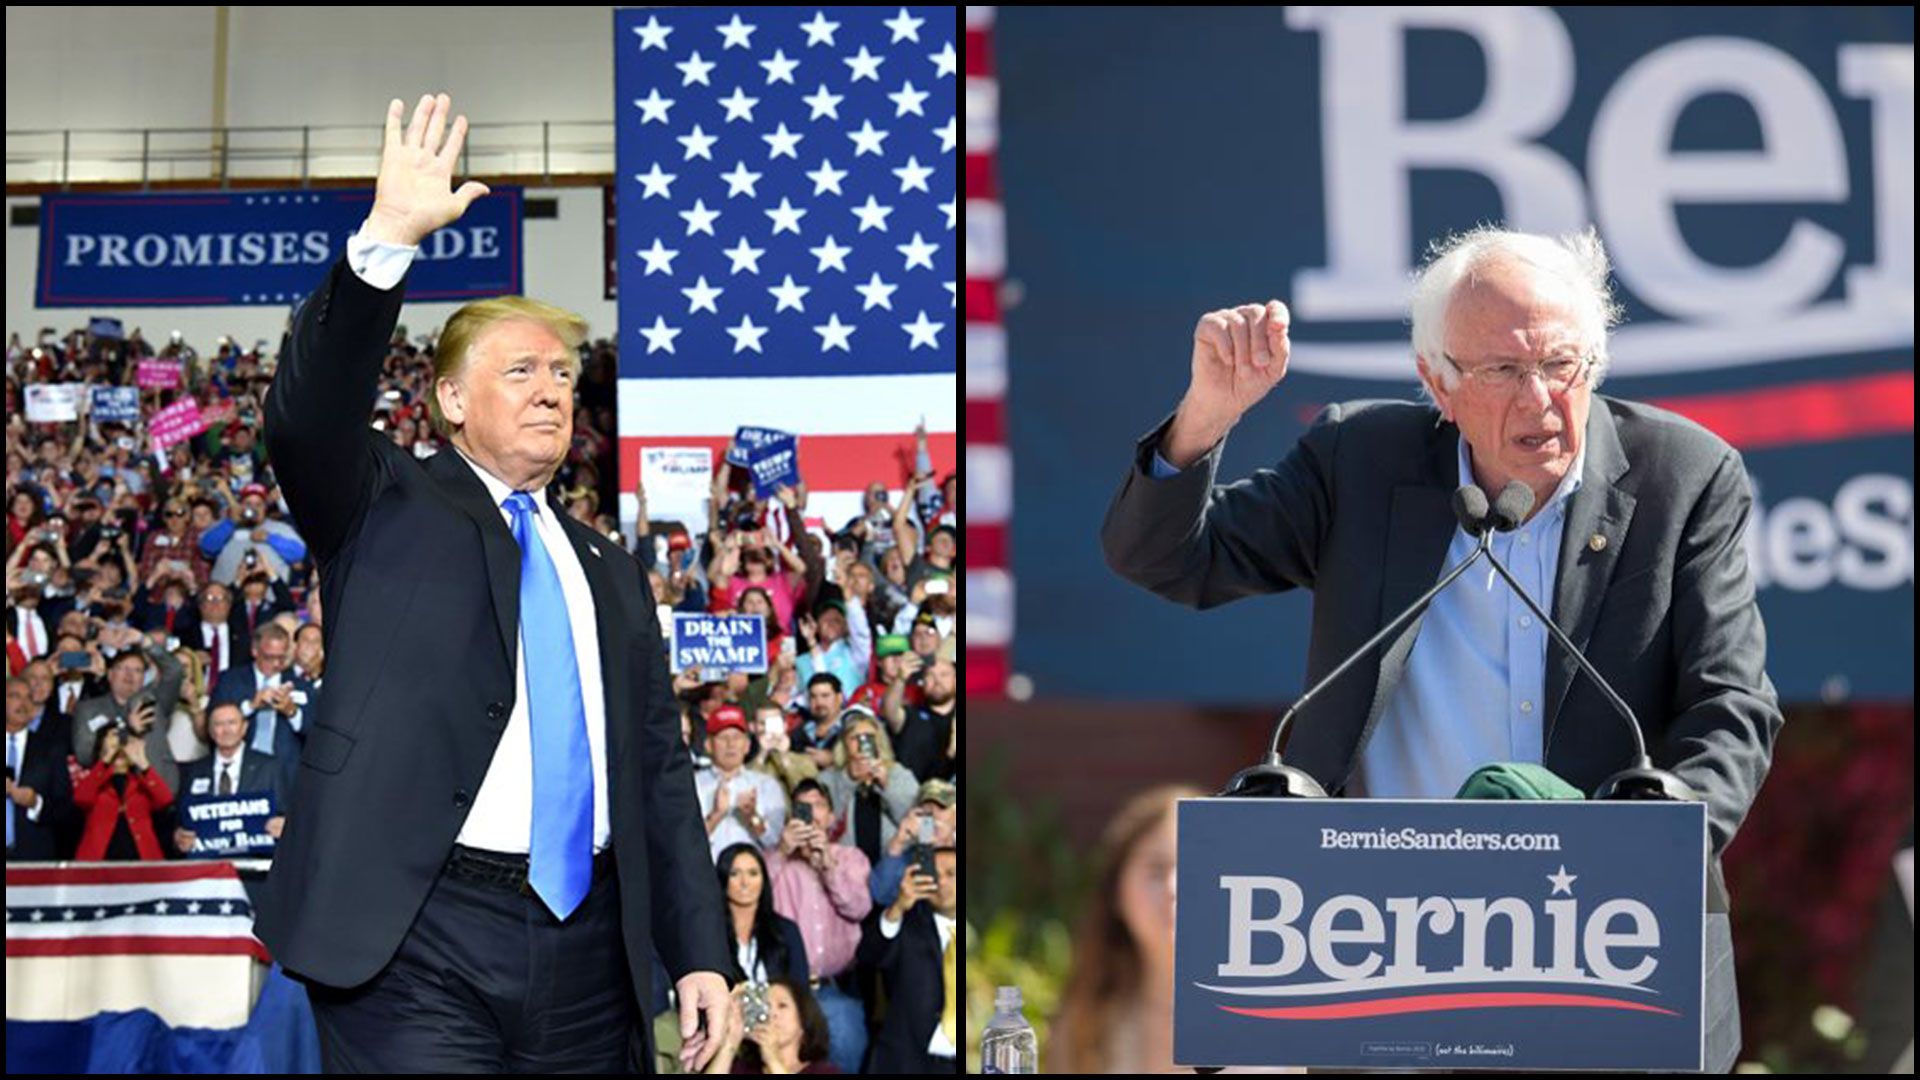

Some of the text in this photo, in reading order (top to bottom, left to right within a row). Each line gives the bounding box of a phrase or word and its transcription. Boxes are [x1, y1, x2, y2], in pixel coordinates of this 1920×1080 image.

[64, 231, 331, 268] PROMISES
[685, 620, 753, 636] DRAIN
[706, 635, 732, 648] THE
[680, 647, 759, 665] SWAMP
[188, 798, 270, 821] VETERANS
[219, 818, 243, 831] FOR
[1320, 828, 1561, 851] BernieSanders.com
[1217, 865, 1661, 982] Bernie
